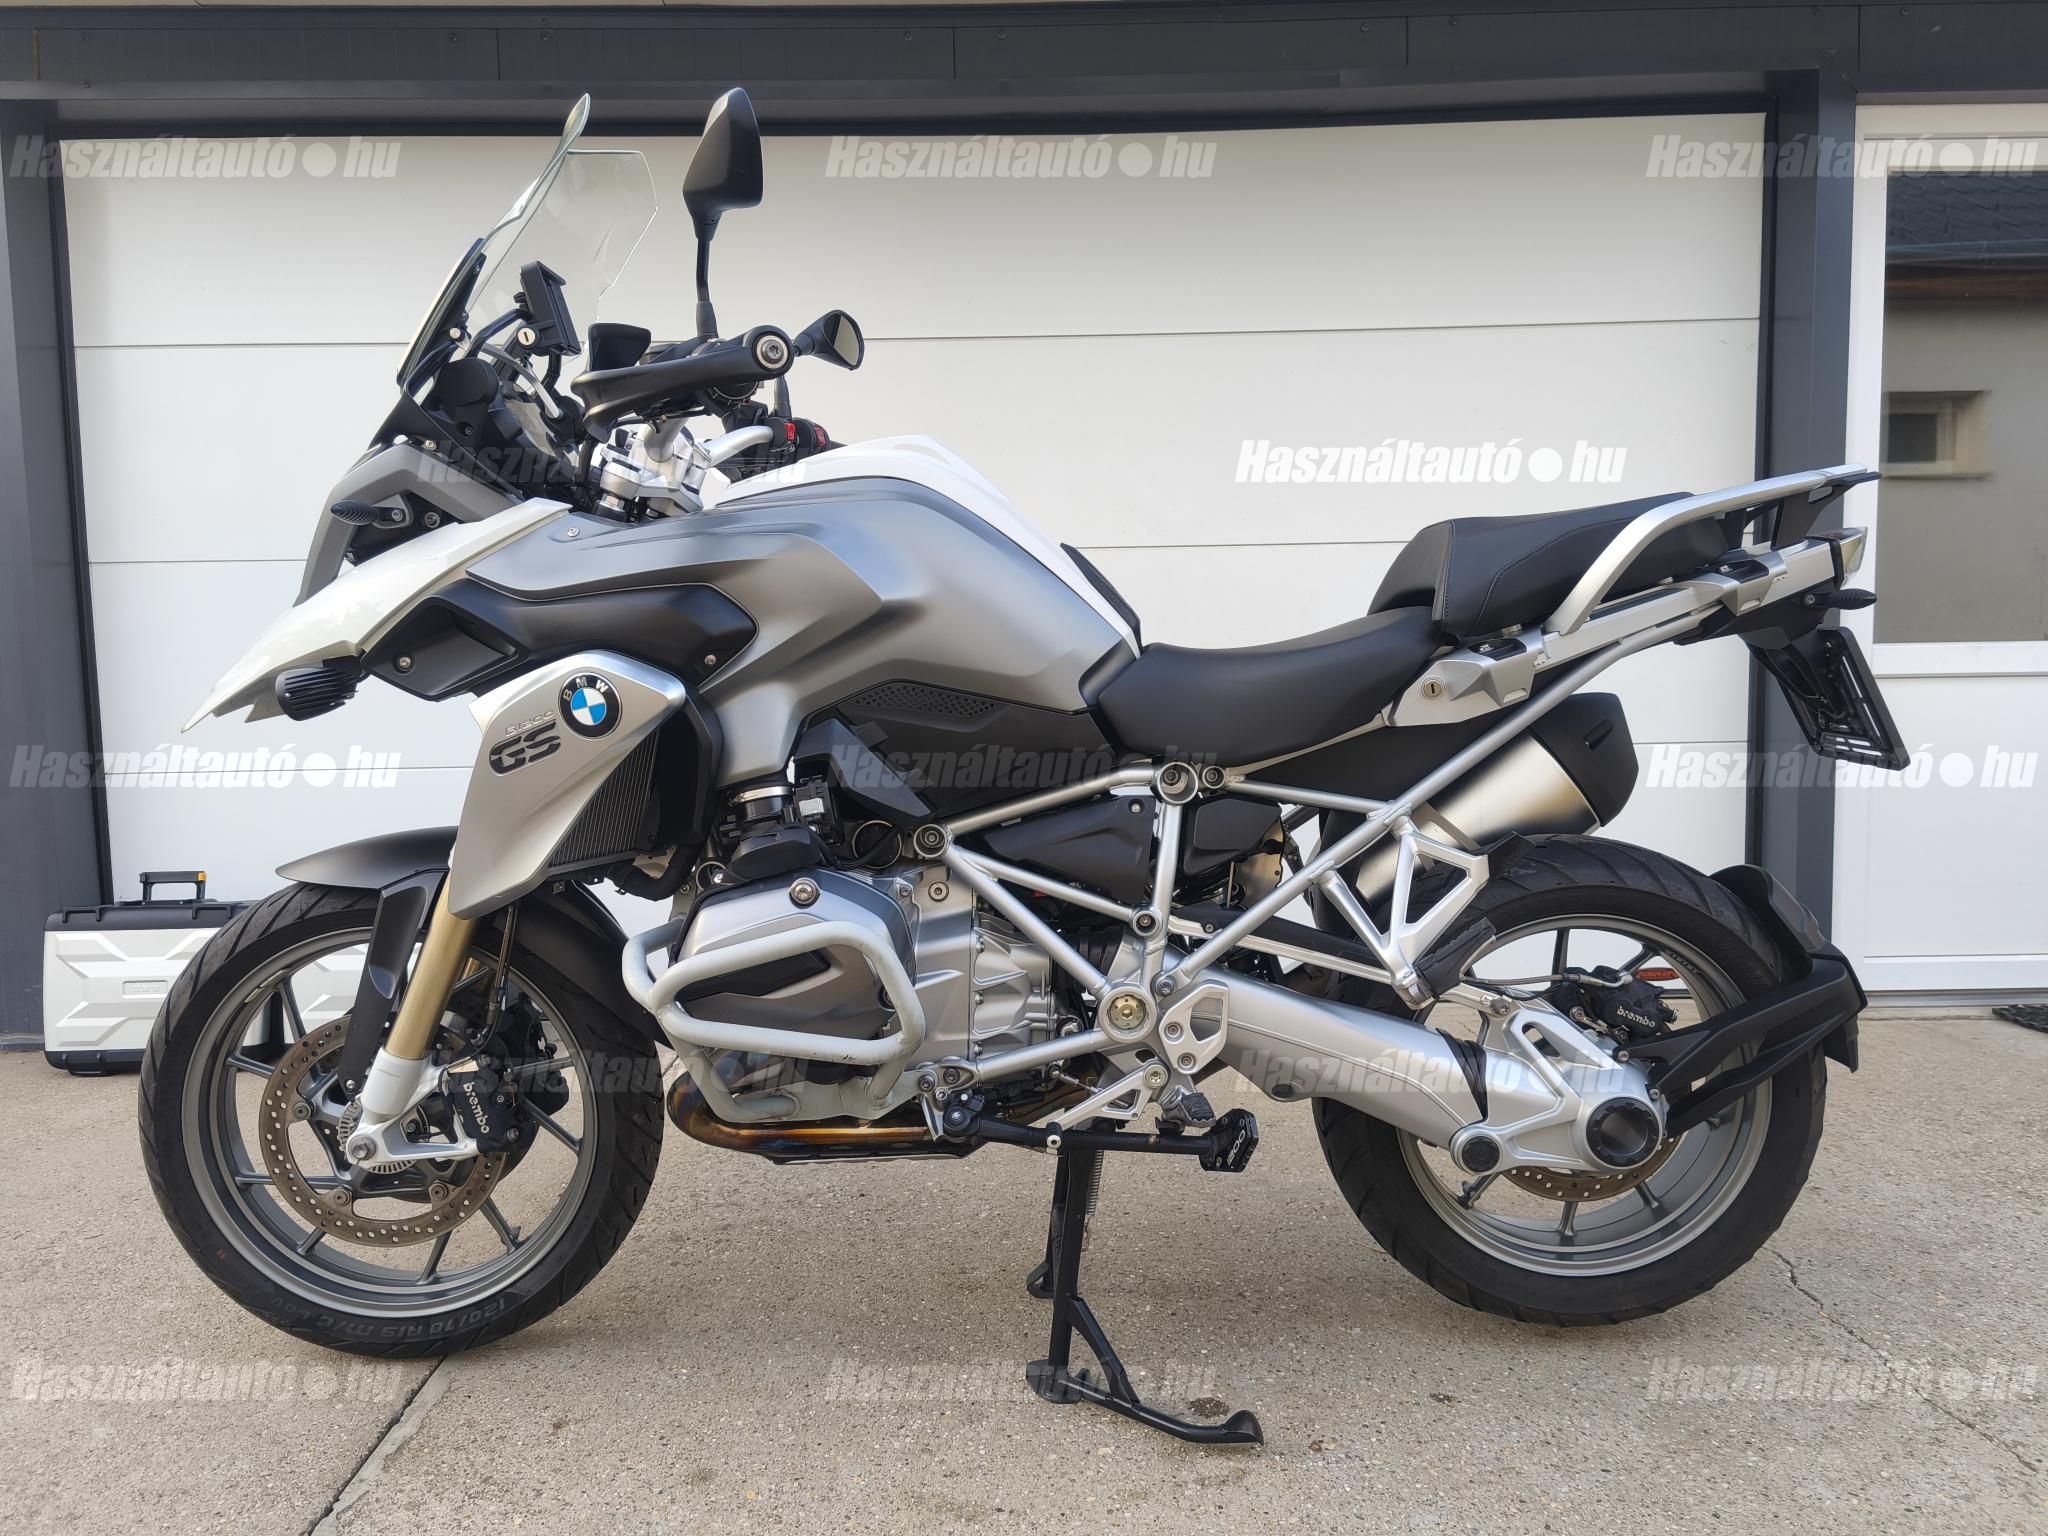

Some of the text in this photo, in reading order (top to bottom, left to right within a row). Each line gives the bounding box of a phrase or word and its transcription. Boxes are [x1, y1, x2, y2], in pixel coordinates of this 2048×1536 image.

[562, 676, 608, 701] BMW
[489, 719, 561, 776] GS
[1616, 1005, 1656, 1028] brembo
[463, 1081, 490, 1134] brembo
